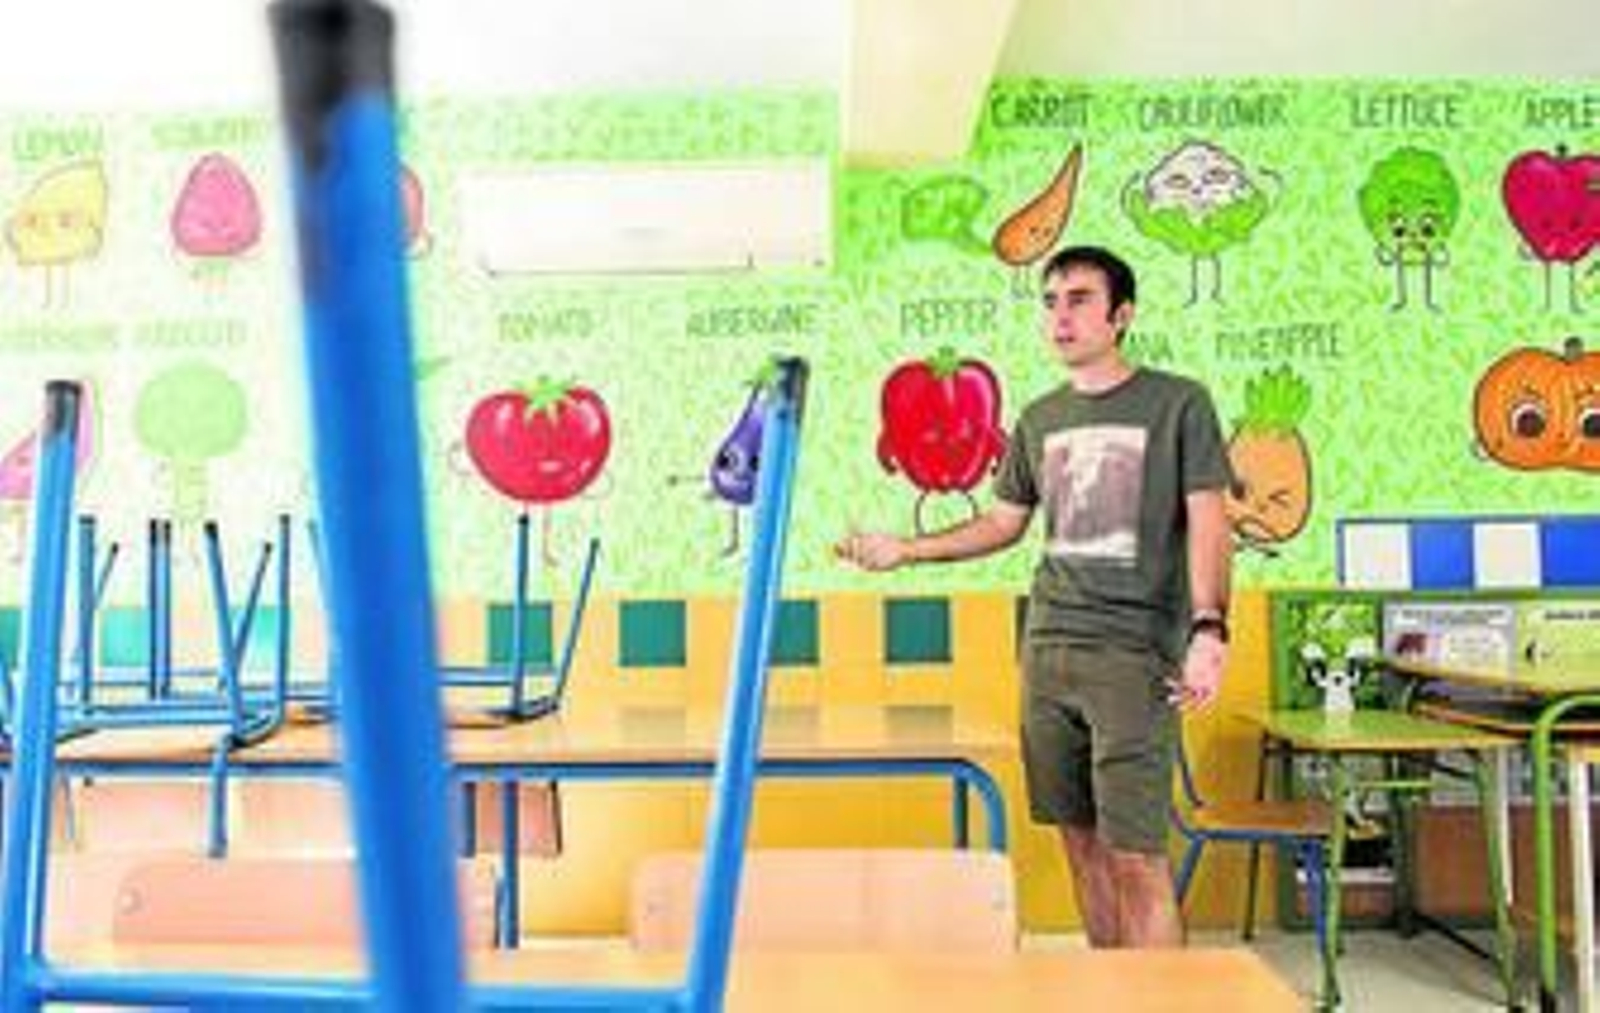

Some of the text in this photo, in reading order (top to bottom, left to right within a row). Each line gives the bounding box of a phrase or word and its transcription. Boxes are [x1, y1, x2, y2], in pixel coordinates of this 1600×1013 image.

[991, 93, 1092, 127] CARROT
[1352, 93, 1463, 127] LETTUCE
[900, 298, 998, 336] PEPPER
[1215, 323, 1342, 360] PINEAPPLE
